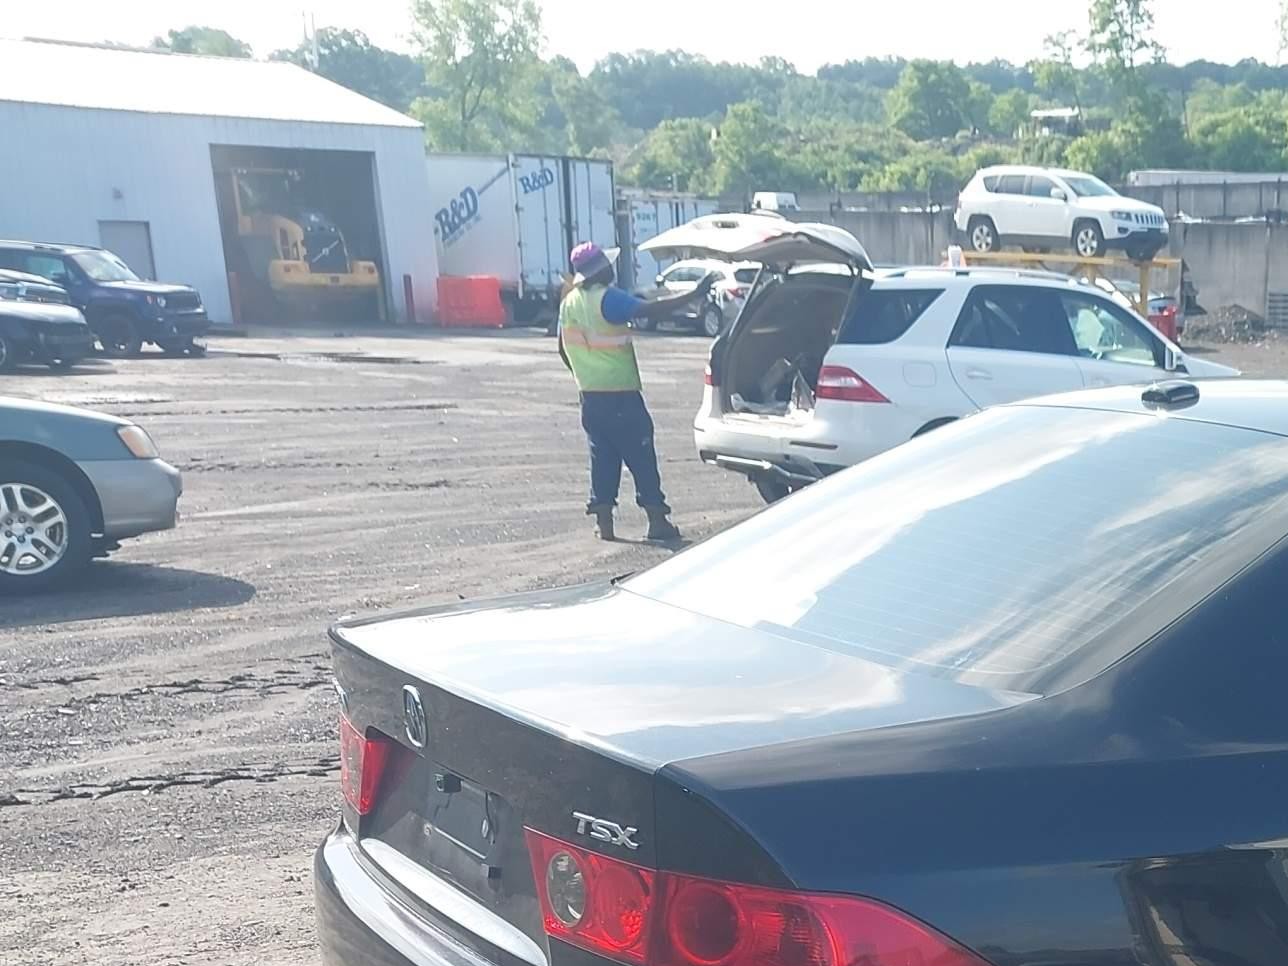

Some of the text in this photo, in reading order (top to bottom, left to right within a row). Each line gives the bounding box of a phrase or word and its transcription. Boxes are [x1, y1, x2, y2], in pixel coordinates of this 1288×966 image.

[519, 167, 554, 194] R&D
[434, 186, 478, 242] R&D
[572, 811, 640, 850] TSX
